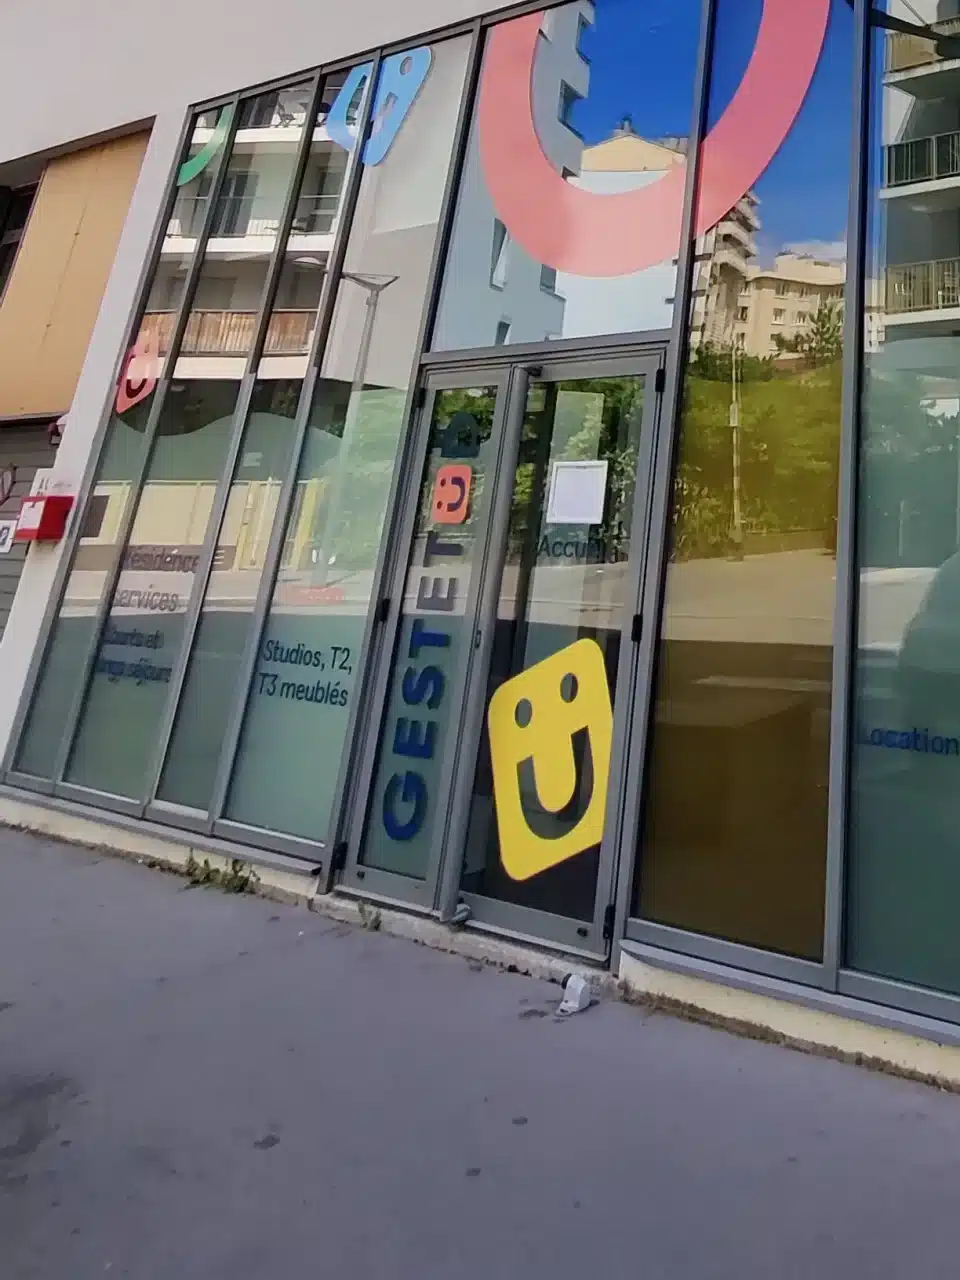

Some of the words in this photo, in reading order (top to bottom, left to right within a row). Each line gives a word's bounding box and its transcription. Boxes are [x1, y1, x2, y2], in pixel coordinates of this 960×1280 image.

[263, 639, 325, 671] Studios,
[331, 645, 352, 675] T2,
[258, 672, 279, 696] T3
[280, 680, 349, 707] meublés
